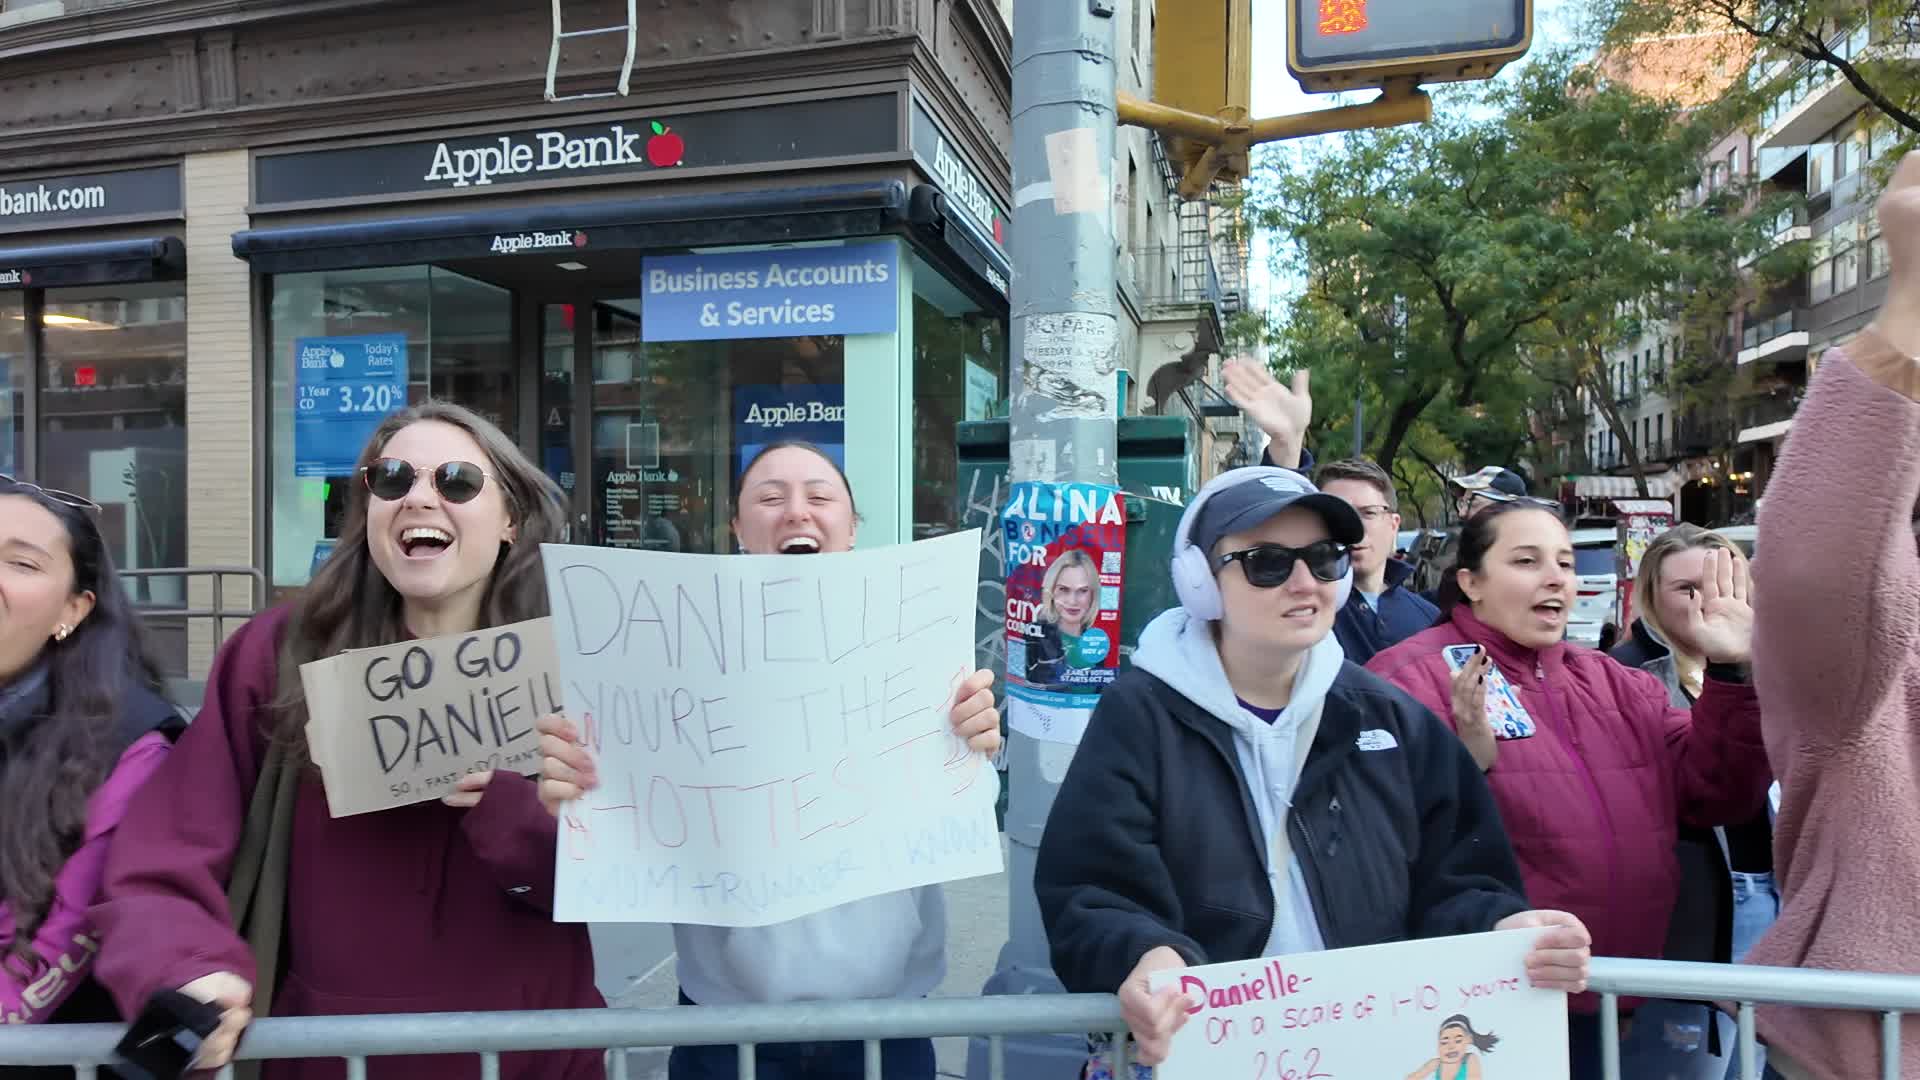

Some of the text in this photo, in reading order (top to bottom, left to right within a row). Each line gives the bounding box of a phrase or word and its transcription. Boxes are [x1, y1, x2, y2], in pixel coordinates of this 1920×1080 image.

[424, 126, 642, 187] Apple Bank
[933, 136, 994, 234] Apple Bank
[490, 230, 573, 253] Apple Bank
[650, 259, 889, 294] Business Accounts
[699, 299, 836, 327] & Services
[302, 346, 331, 360] Apple
[364, 343, 399, 356] Today's
[368, 355, 393, 367] Rates
[301, 357, 329, 369] Bank
[308, 385, 331, 397] Year
[299, 399, 315, 409] CD
[744, 403, 807, 427] Apple
[606, 471, 636, 485] Apple
[1003, 485, 1123, 526] ALINA
[1008, 541, 1047, 567] FOR
[560, 557, 959, 674] DANIELLE
[1006, 598, 1044, 623] CITY
[1006, 618, 1045, 638] COUNCIL
[365, 632, 521, 702] GO GO
[571, 667, 930, 766] YOU'RE THE
[586, 729, 941, 850] HOTTEST
[1251, 1016, 1265, 1036] a
[1282, 1003, 1344, 1029] scale
[1353, 995, 1376, 1021] of
[1391, 985, 1440, 1011] 1-10
